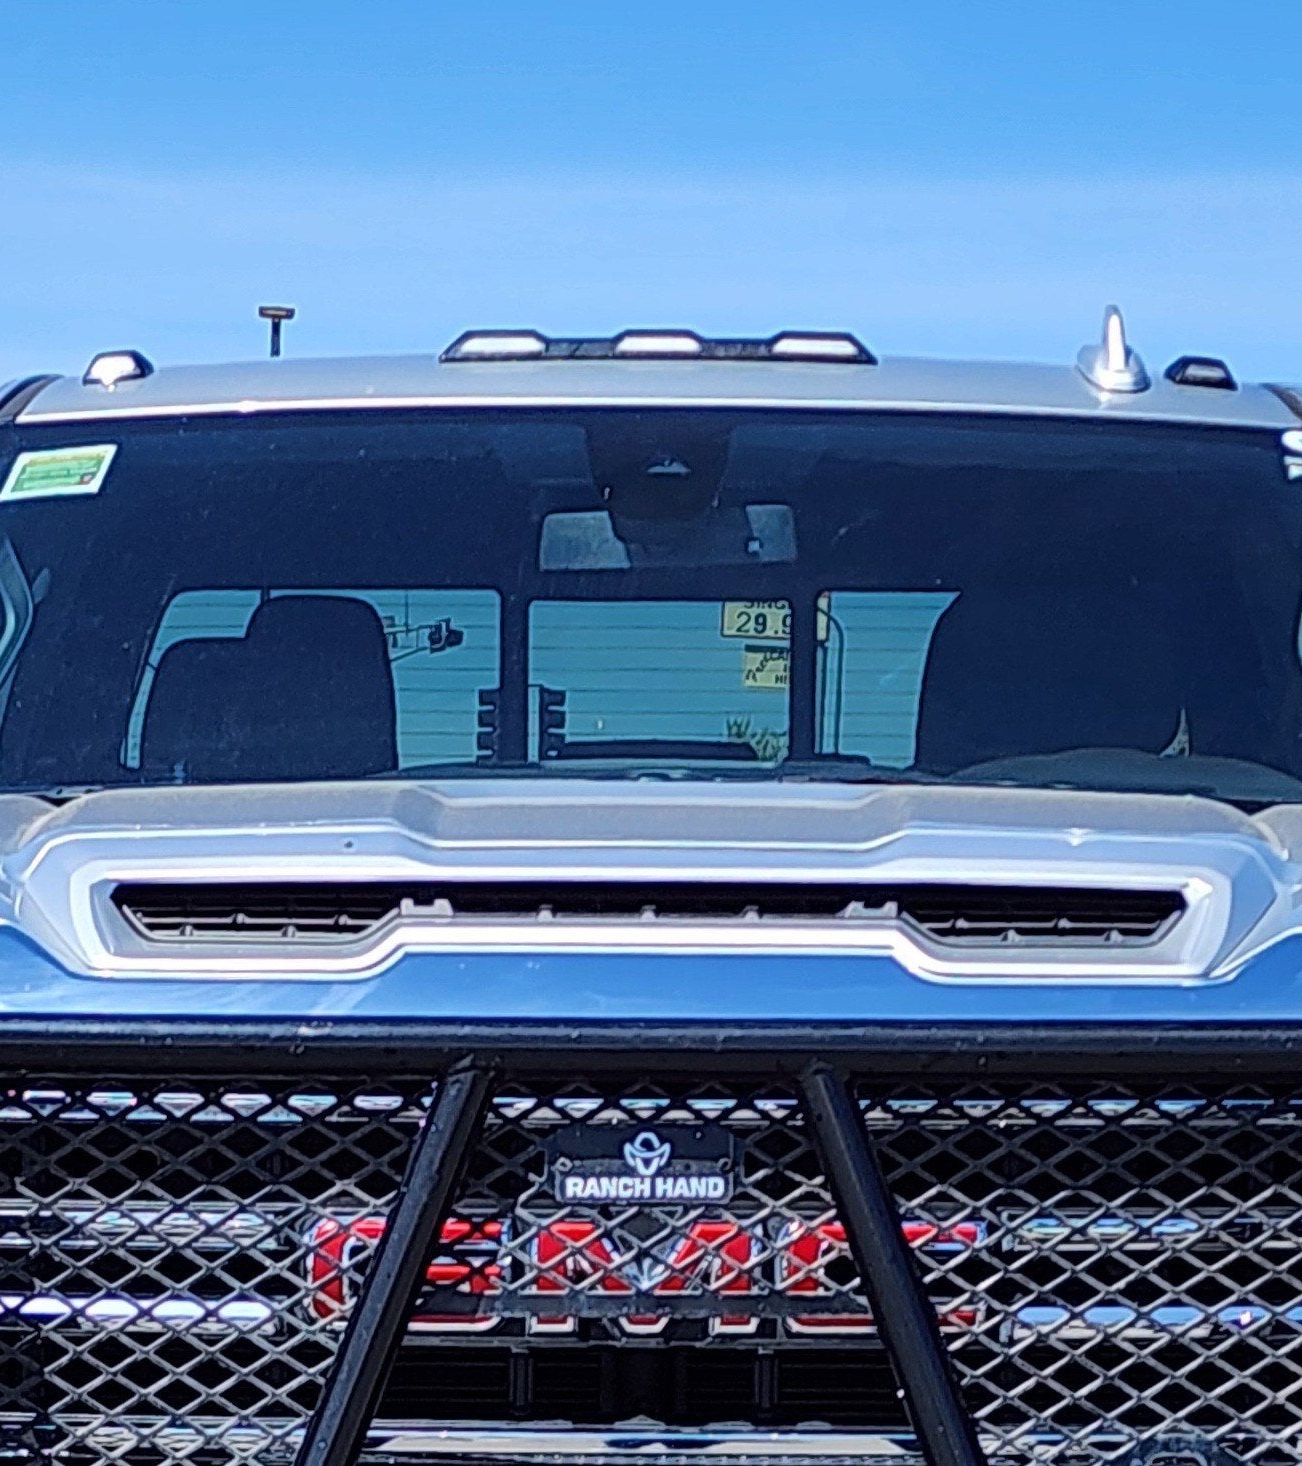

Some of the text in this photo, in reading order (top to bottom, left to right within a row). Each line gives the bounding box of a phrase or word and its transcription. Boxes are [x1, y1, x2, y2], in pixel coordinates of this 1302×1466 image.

[565, 1176, 725, 1198] RANCH HAND
[303, 1218, 988, 1334] GMC
